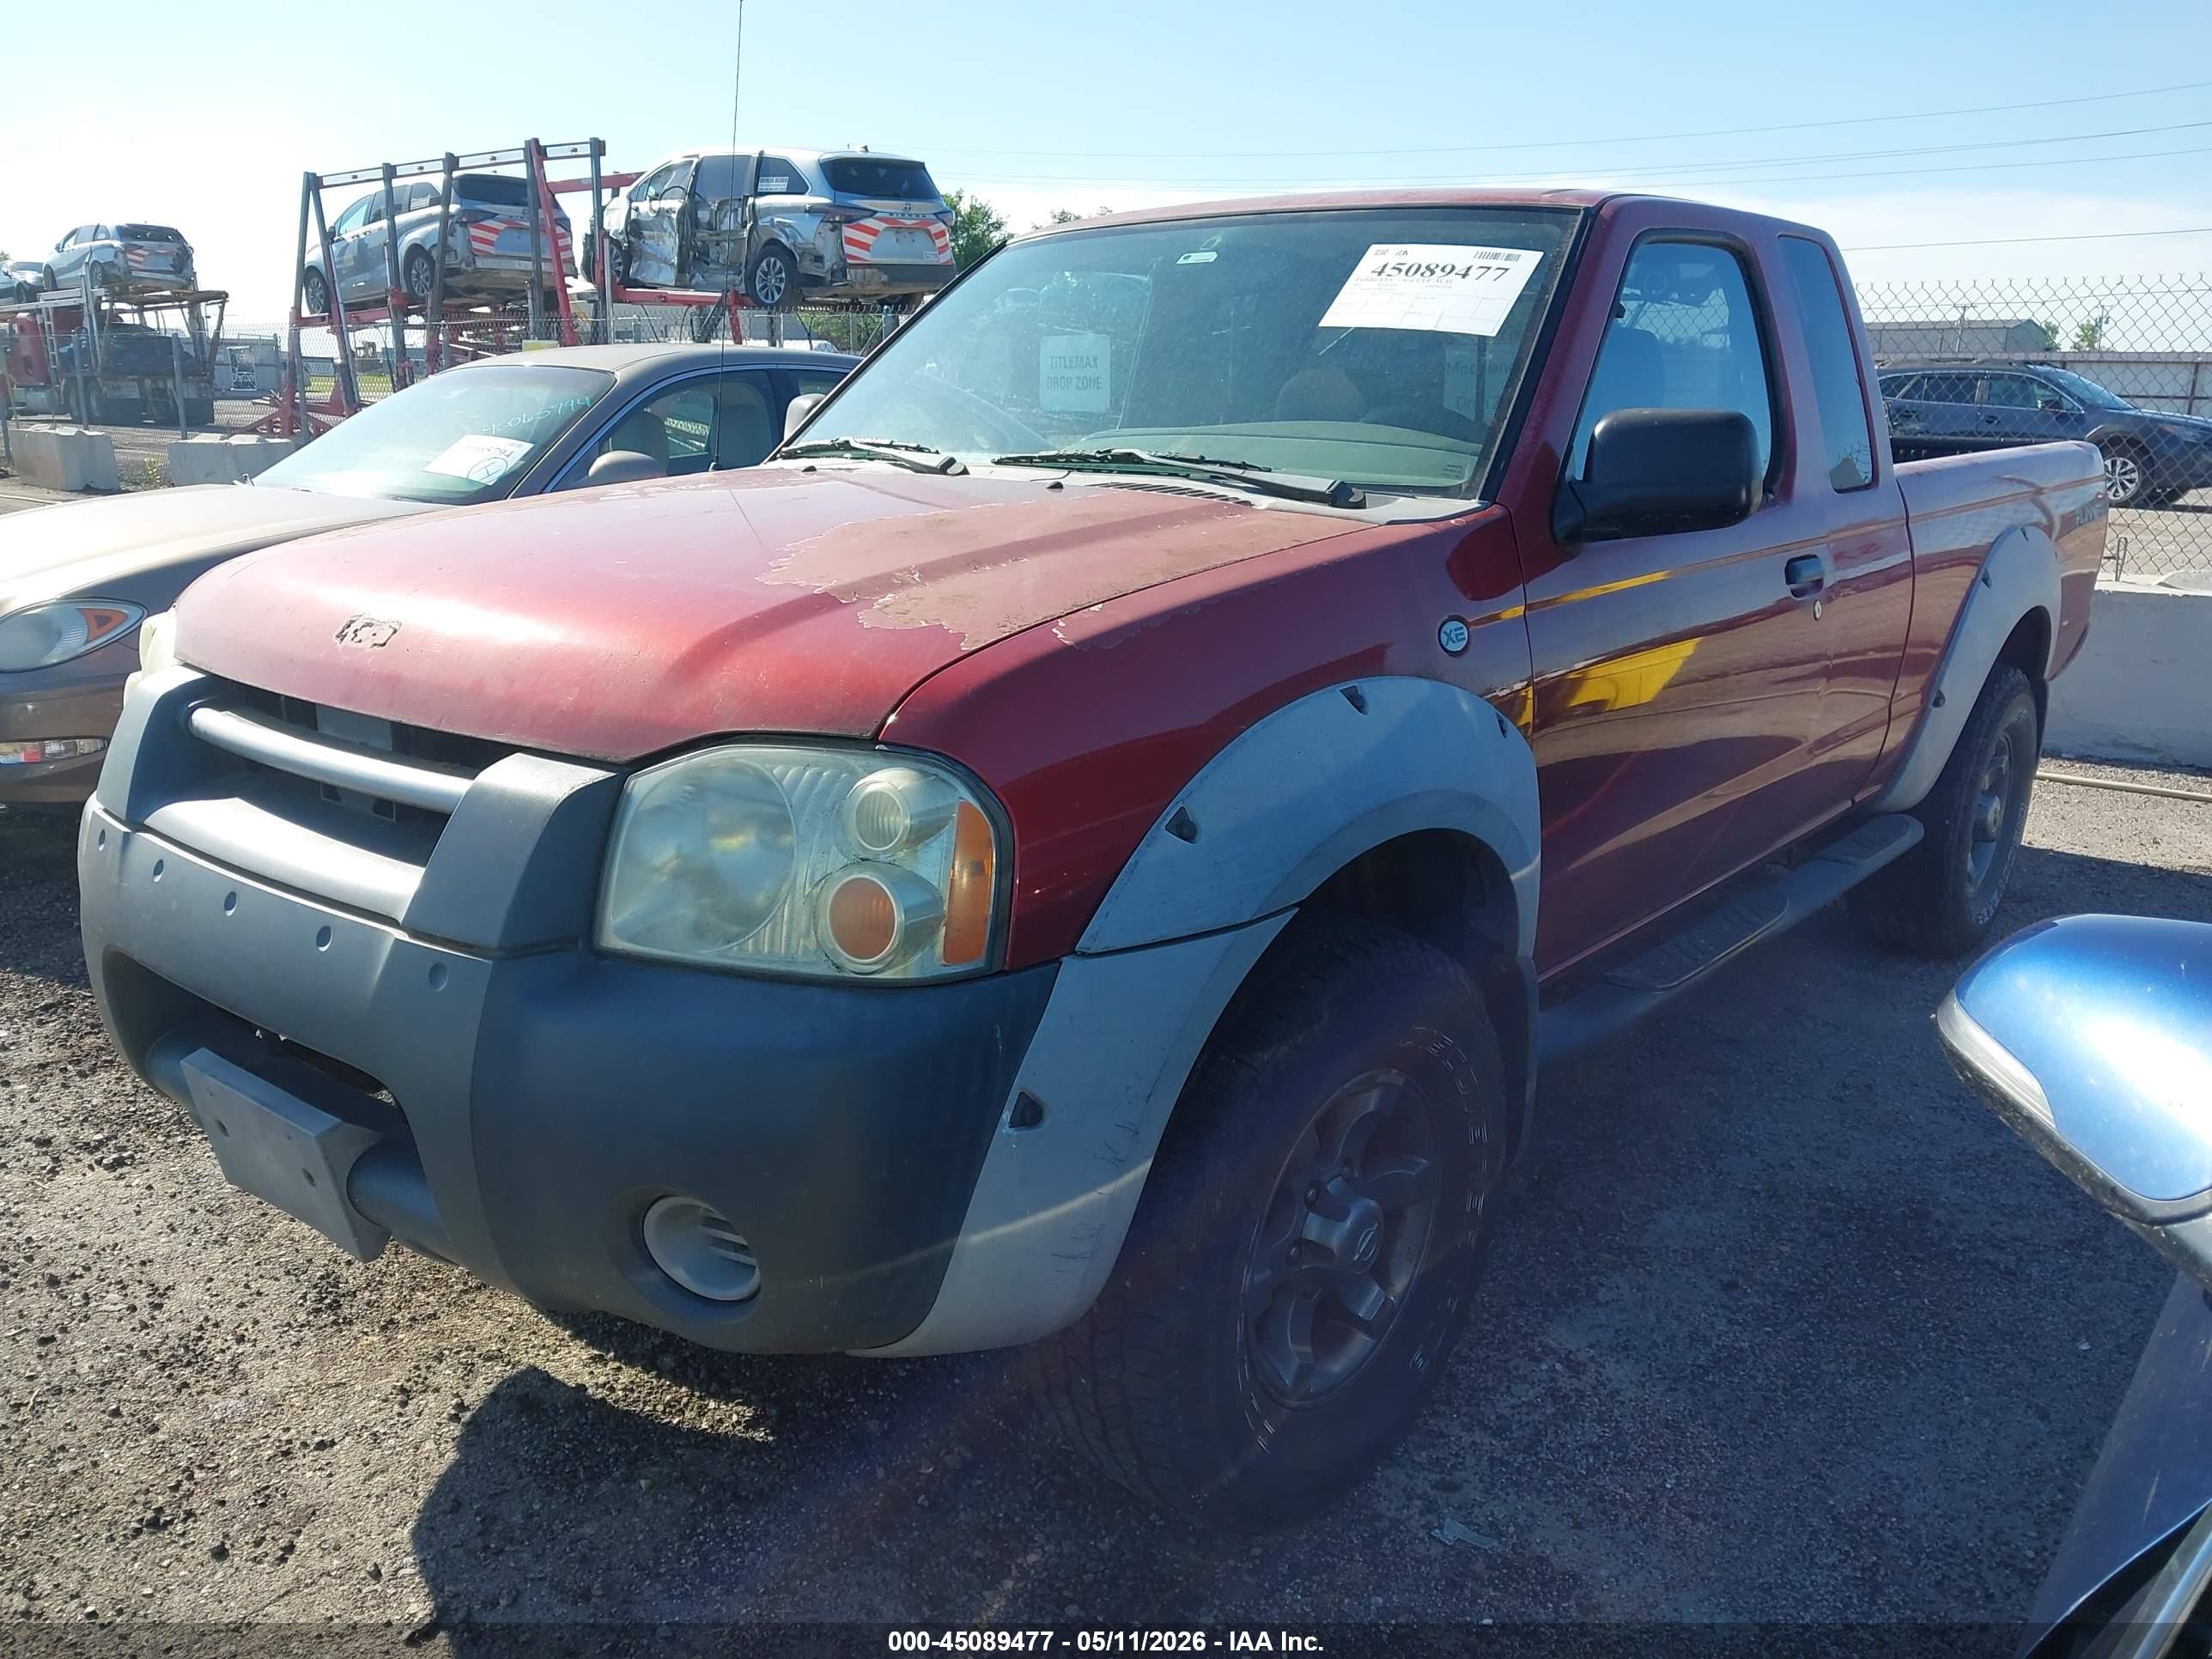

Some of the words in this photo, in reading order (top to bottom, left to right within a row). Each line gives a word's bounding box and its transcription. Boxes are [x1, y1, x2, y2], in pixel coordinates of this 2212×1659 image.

[1370, 262, 1511, 282] 45089477
[1046, 376, 1073, 390] DROP
[1076, 376, 1103, 390] ZONE
[1443, 626, 1466, 647] XE
